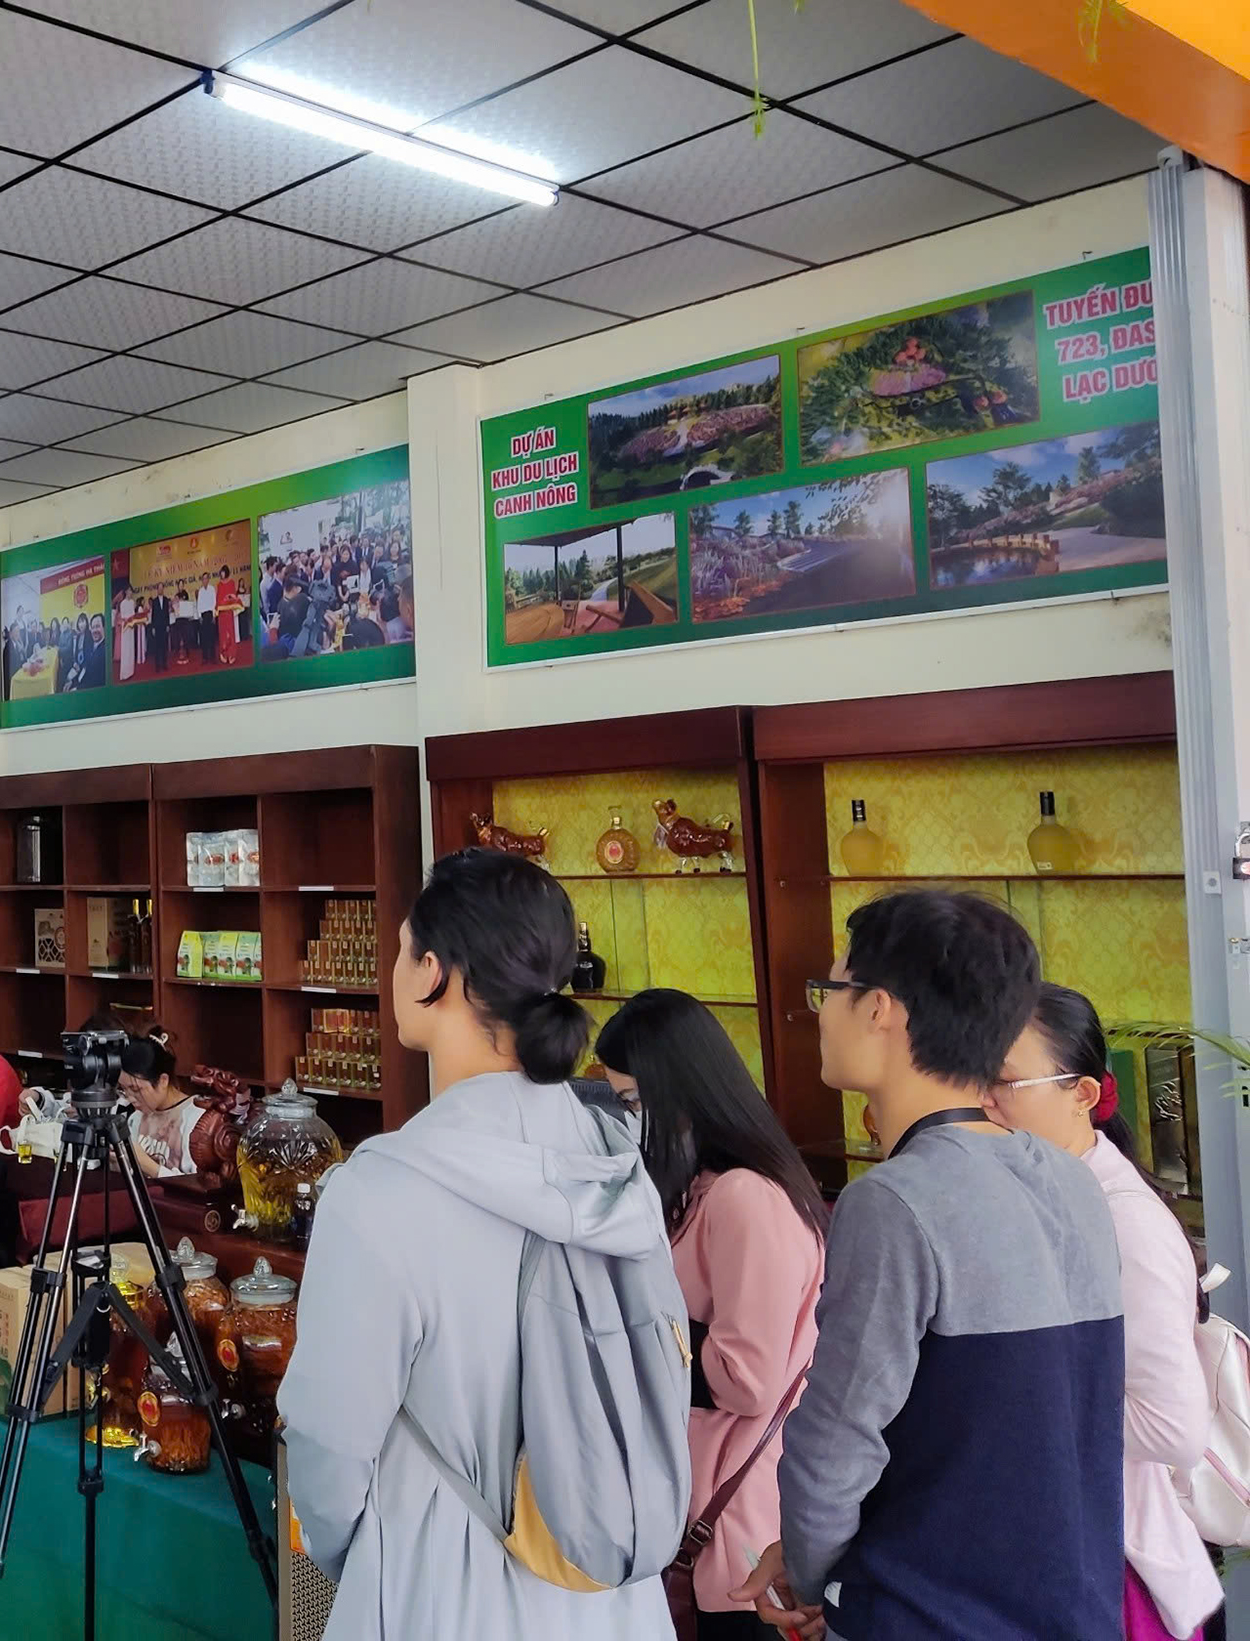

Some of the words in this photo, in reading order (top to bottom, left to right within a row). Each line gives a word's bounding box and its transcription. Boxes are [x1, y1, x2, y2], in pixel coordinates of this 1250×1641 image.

[1043, 282, 1120, 330] TUYẾN
[1055, 331, 1108, 365] 723,
[1063, 368, 1110, 404] LẠC
[511, 431, 534, 459] DỰ
[533, 426, 556, 453] ÁN
[491, 465, 521, 492] KHU
[521, 460, 543, 485] DU
[544, 451, 579, 482] LỊCH
[494, 491, 534, 519] CANH
[534, 482, 578, 511] NÔNG
